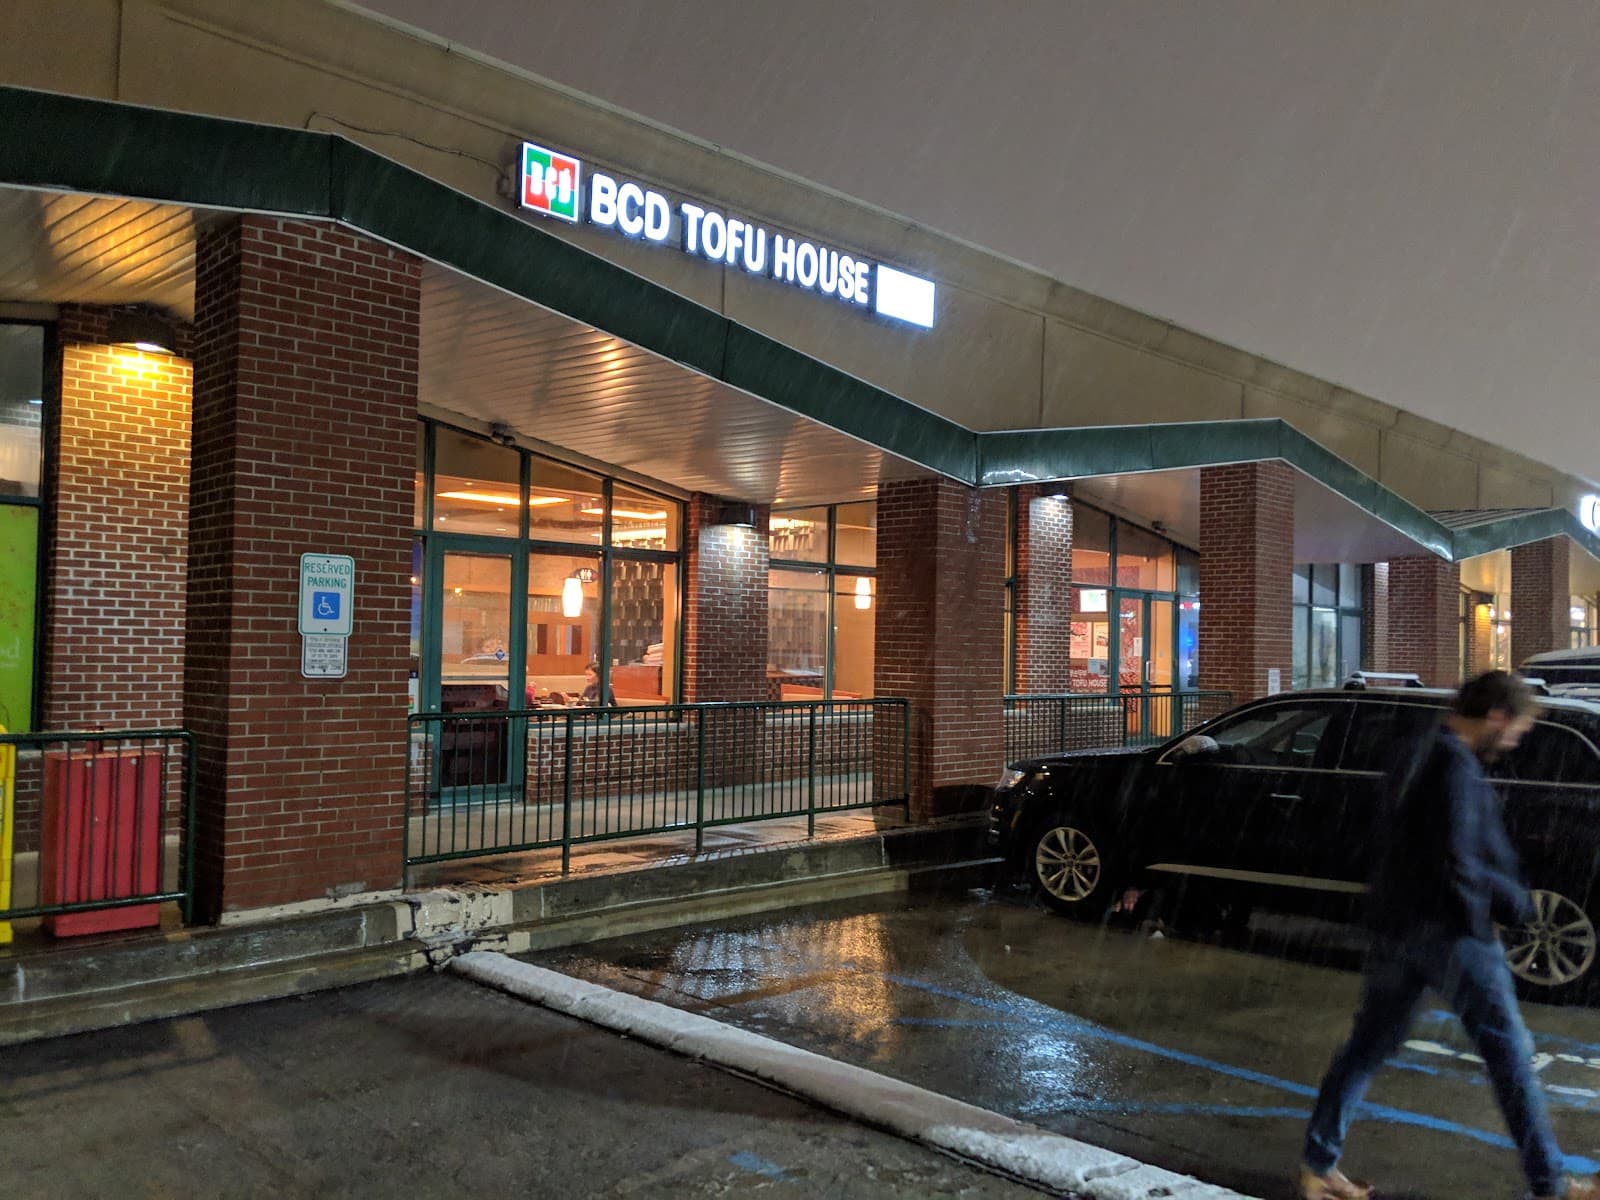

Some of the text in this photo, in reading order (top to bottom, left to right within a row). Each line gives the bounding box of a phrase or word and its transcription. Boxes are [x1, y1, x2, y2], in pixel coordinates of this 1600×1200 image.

[590, 172, 870, 304] BCD TOFU HOUSE
[304, 562, 351, 576] RESERVED
[307, 576, 347, 589] PARKING
[1072, 679, 1108, 688] TOFU HOUSE
